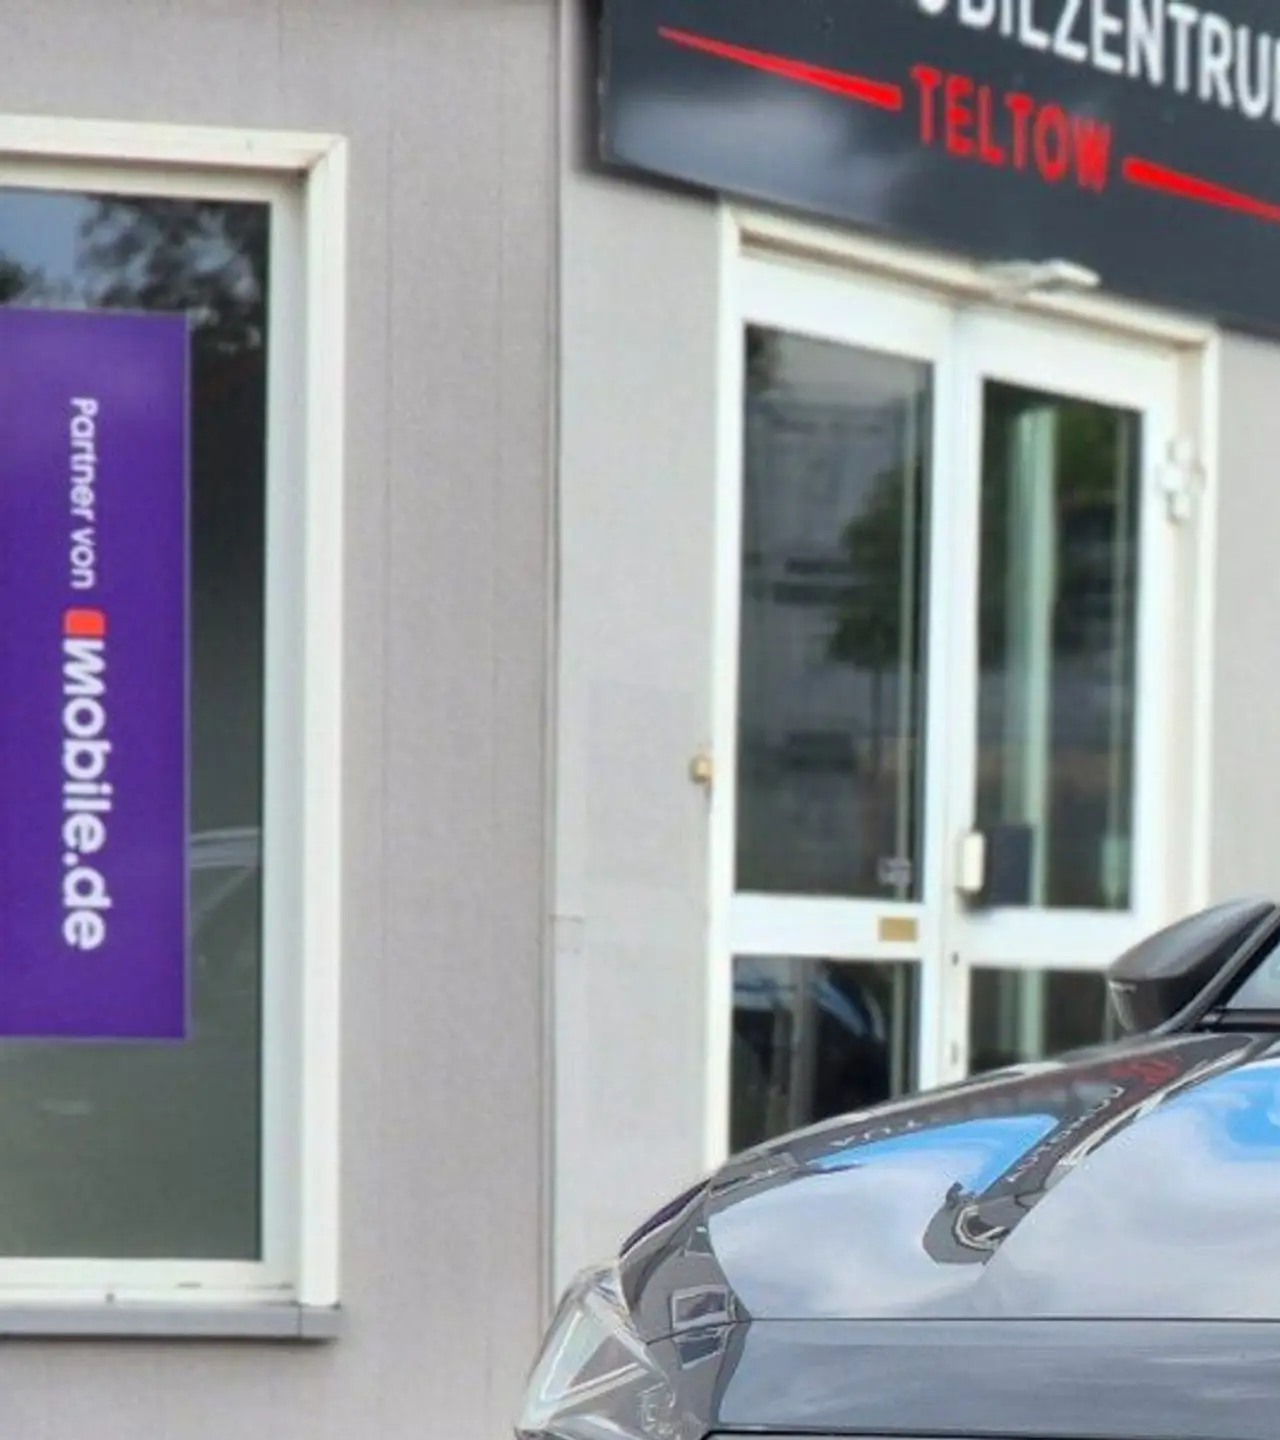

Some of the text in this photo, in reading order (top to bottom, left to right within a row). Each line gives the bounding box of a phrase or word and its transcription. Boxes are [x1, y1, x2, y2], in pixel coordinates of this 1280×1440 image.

[909, 63, 1113, 193] TELTOW
[69, 398, 99, 590] Partner von
[62, 638, 112, 951] mobile.de
